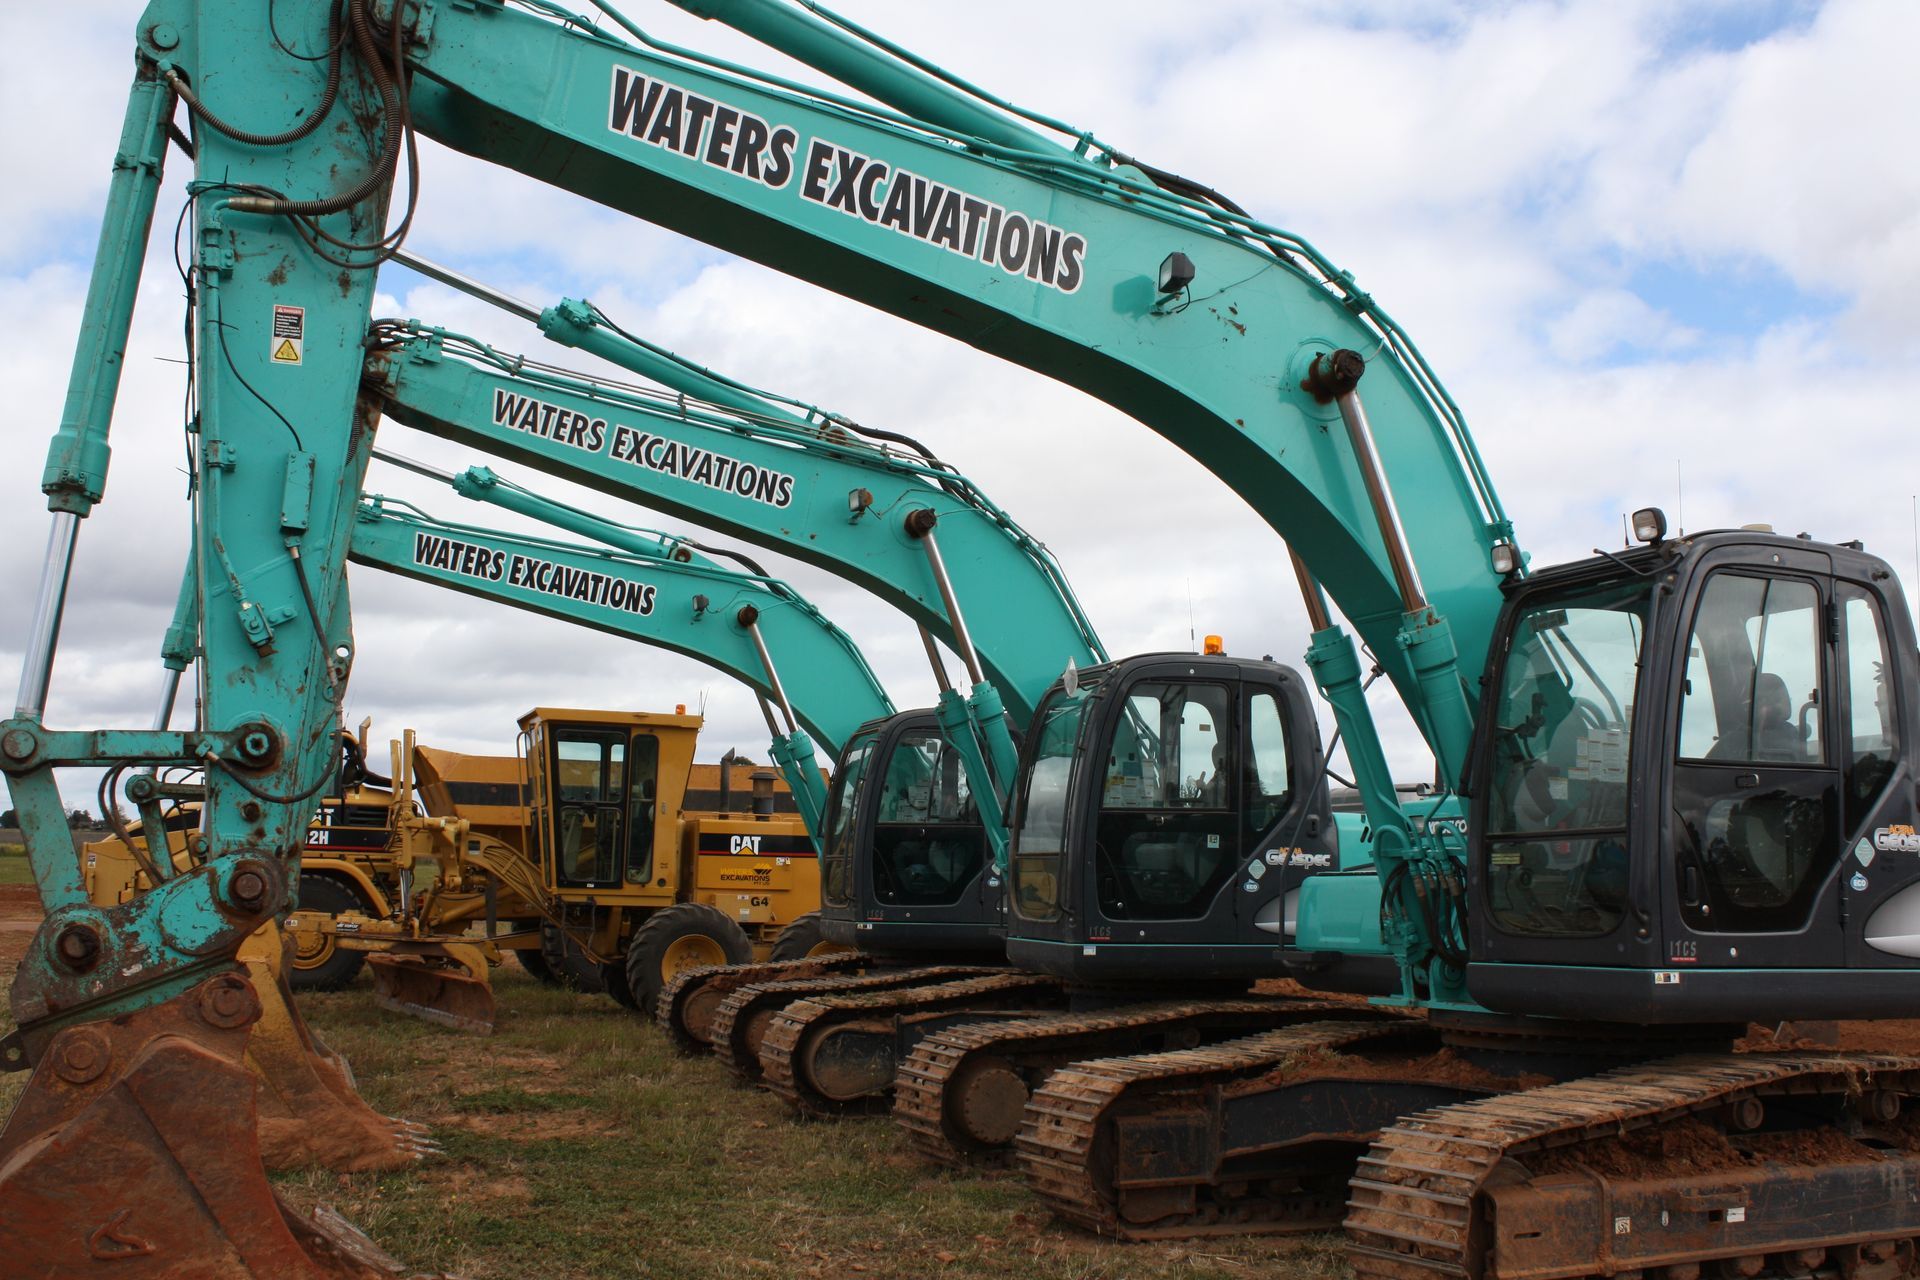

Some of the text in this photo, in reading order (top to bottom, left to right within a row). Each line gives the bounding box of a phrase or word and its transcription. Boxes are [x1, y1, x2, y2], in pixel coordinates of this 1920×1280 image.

[608, 65, 1088, 295] WATERS EXCAVATIONS
[493, 388, 795, 509] WATERS EXCAVATIONS
[414, 531, 656, 616] WATERS EXCAVATIONS
[311, 808, 335, 827] AT
[730, 835, 761, 855] CAT
[720, 874, 770, 882] EXCAVATIONS
[750, 896, 769, 907] G4
[1670, 940, 1697, 957] ITCS
